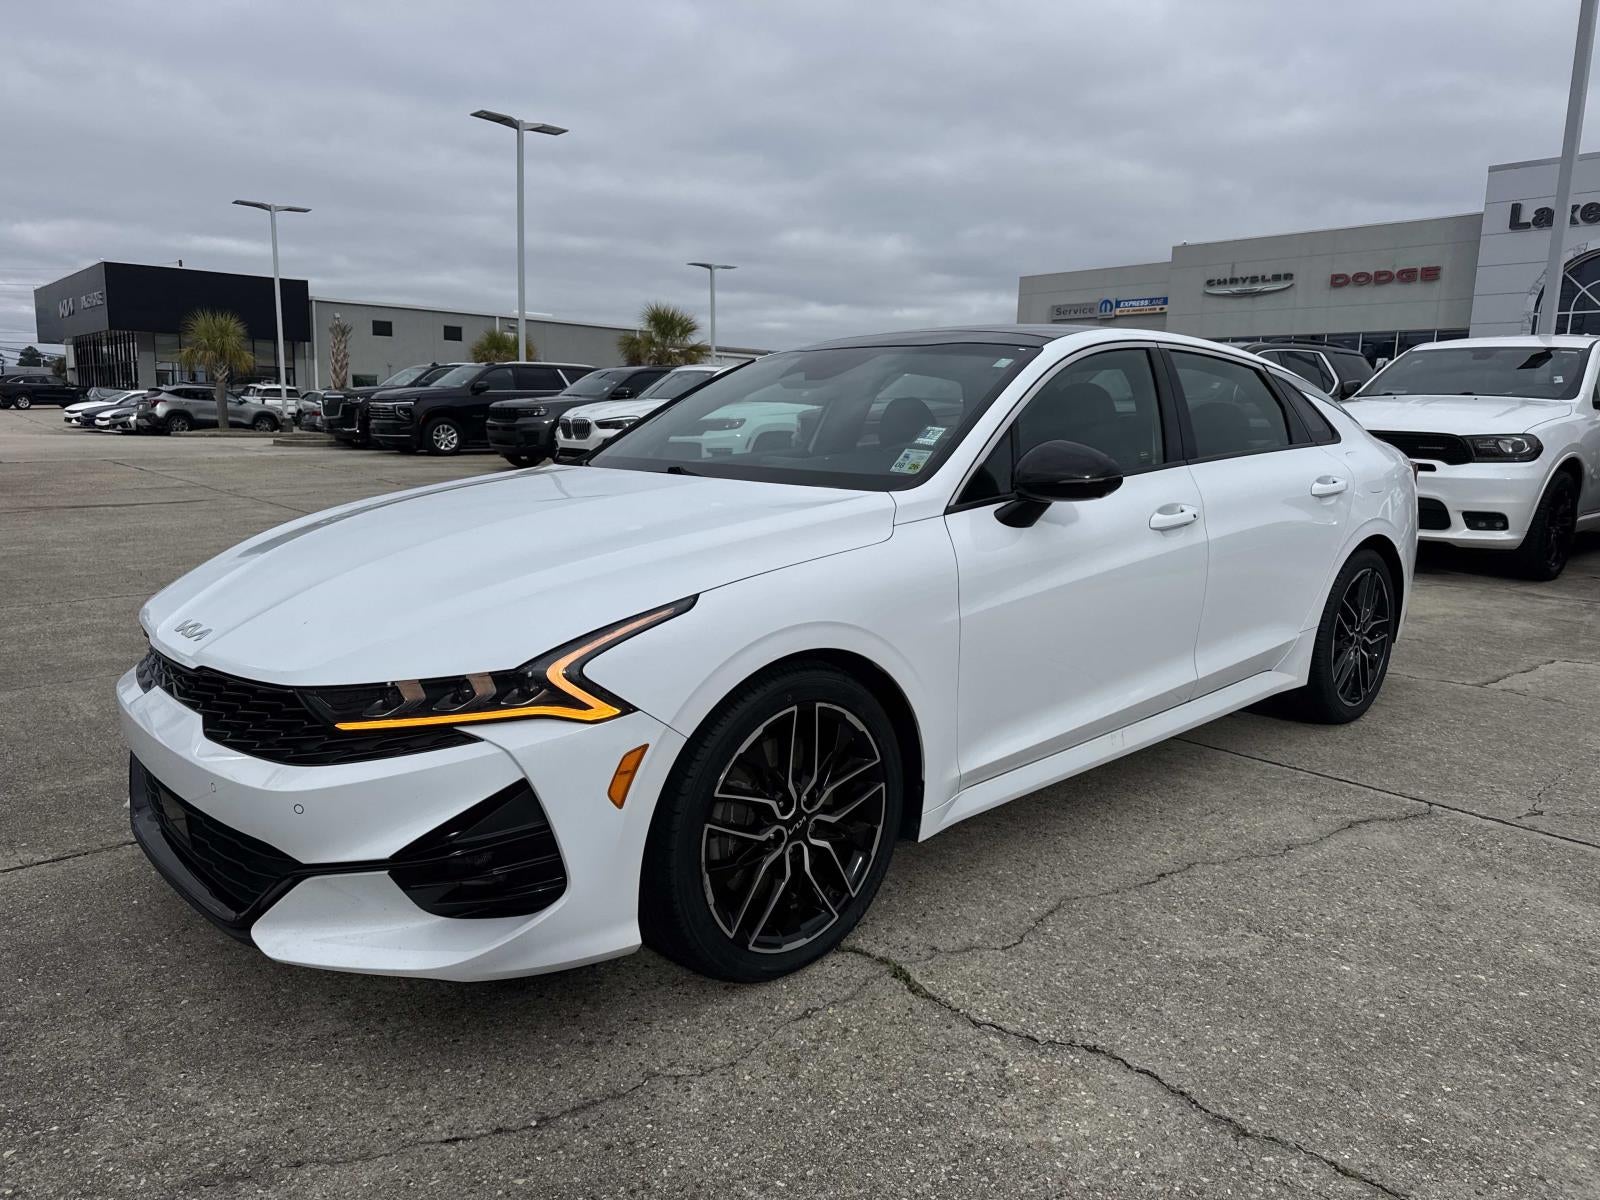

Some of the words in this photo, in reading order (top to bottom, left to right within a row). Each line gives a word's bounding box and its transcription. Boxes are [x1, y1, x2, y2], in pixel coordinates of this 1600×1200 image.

[1206, 273, 1294, 286] CHRYSLER
[1330, 266, 1441, 288] DODGE
[1055, 306, 1095, 316] Service
